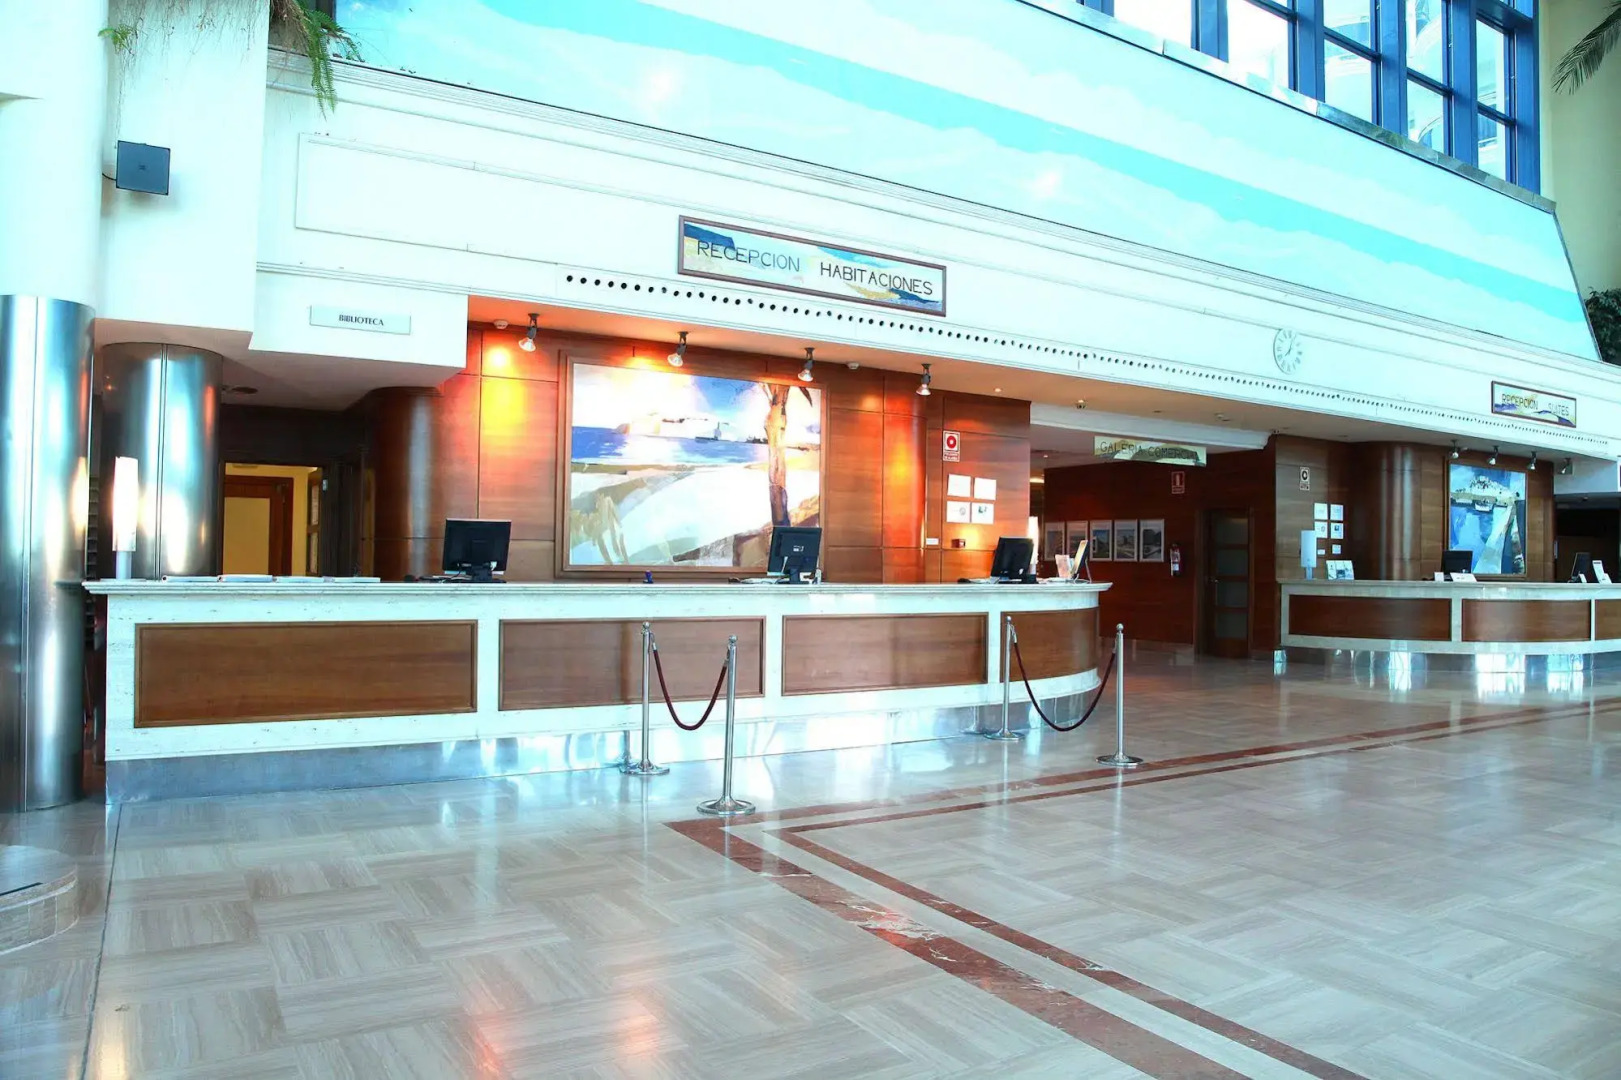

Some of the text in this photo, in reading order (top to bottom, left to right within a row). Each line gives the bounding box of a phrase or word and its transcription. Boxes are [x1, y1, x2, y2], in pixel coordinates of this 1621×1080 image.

[697, 240, 933, 295] RECEPCION HABITACIONES
[338, 314, 384, 326] BIBLIOTECA
[1100, 441, 1143, 456] GALERIA
